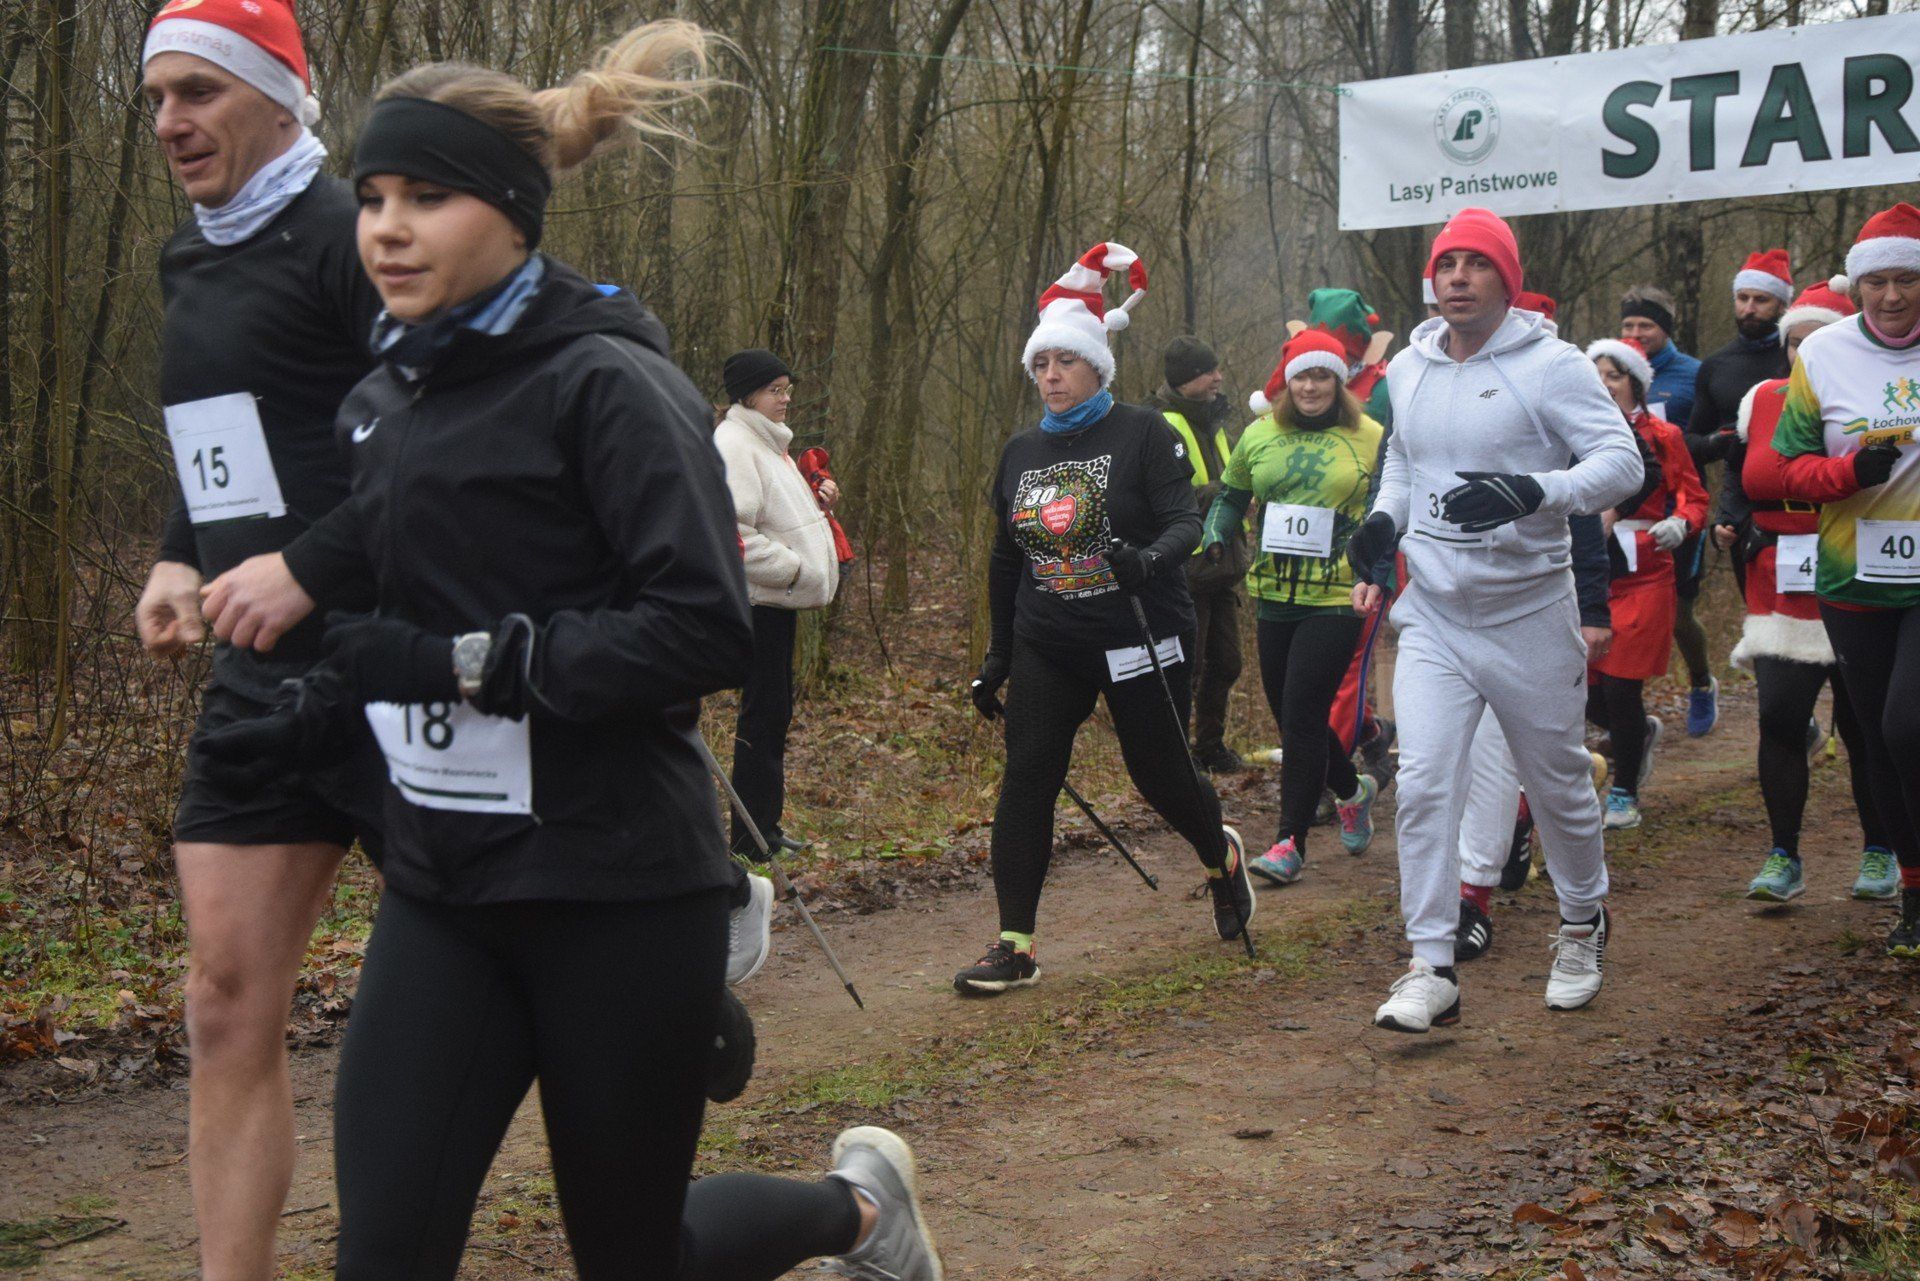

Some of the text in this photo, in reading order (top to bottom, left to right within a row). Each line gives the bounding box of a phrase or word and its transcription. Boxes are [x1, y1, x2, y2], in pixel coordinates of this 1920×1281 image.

[1601, 53, 1920, 180] STAR
[1390, 170, 1558, 204] Lasy Państwowe
[1479, 389, 1499, 399] 4F
[192, 446, 230, 491] 15
[1023, 486, 1058, 508] 30
[1429, 493, 1440, 518] 3
[1284, 515, 1309, 536] 10
[1880, 535, 1915, 559] 40
[1799, 556, 1818, 576] 4
[404, 702, 454, 751] 18
